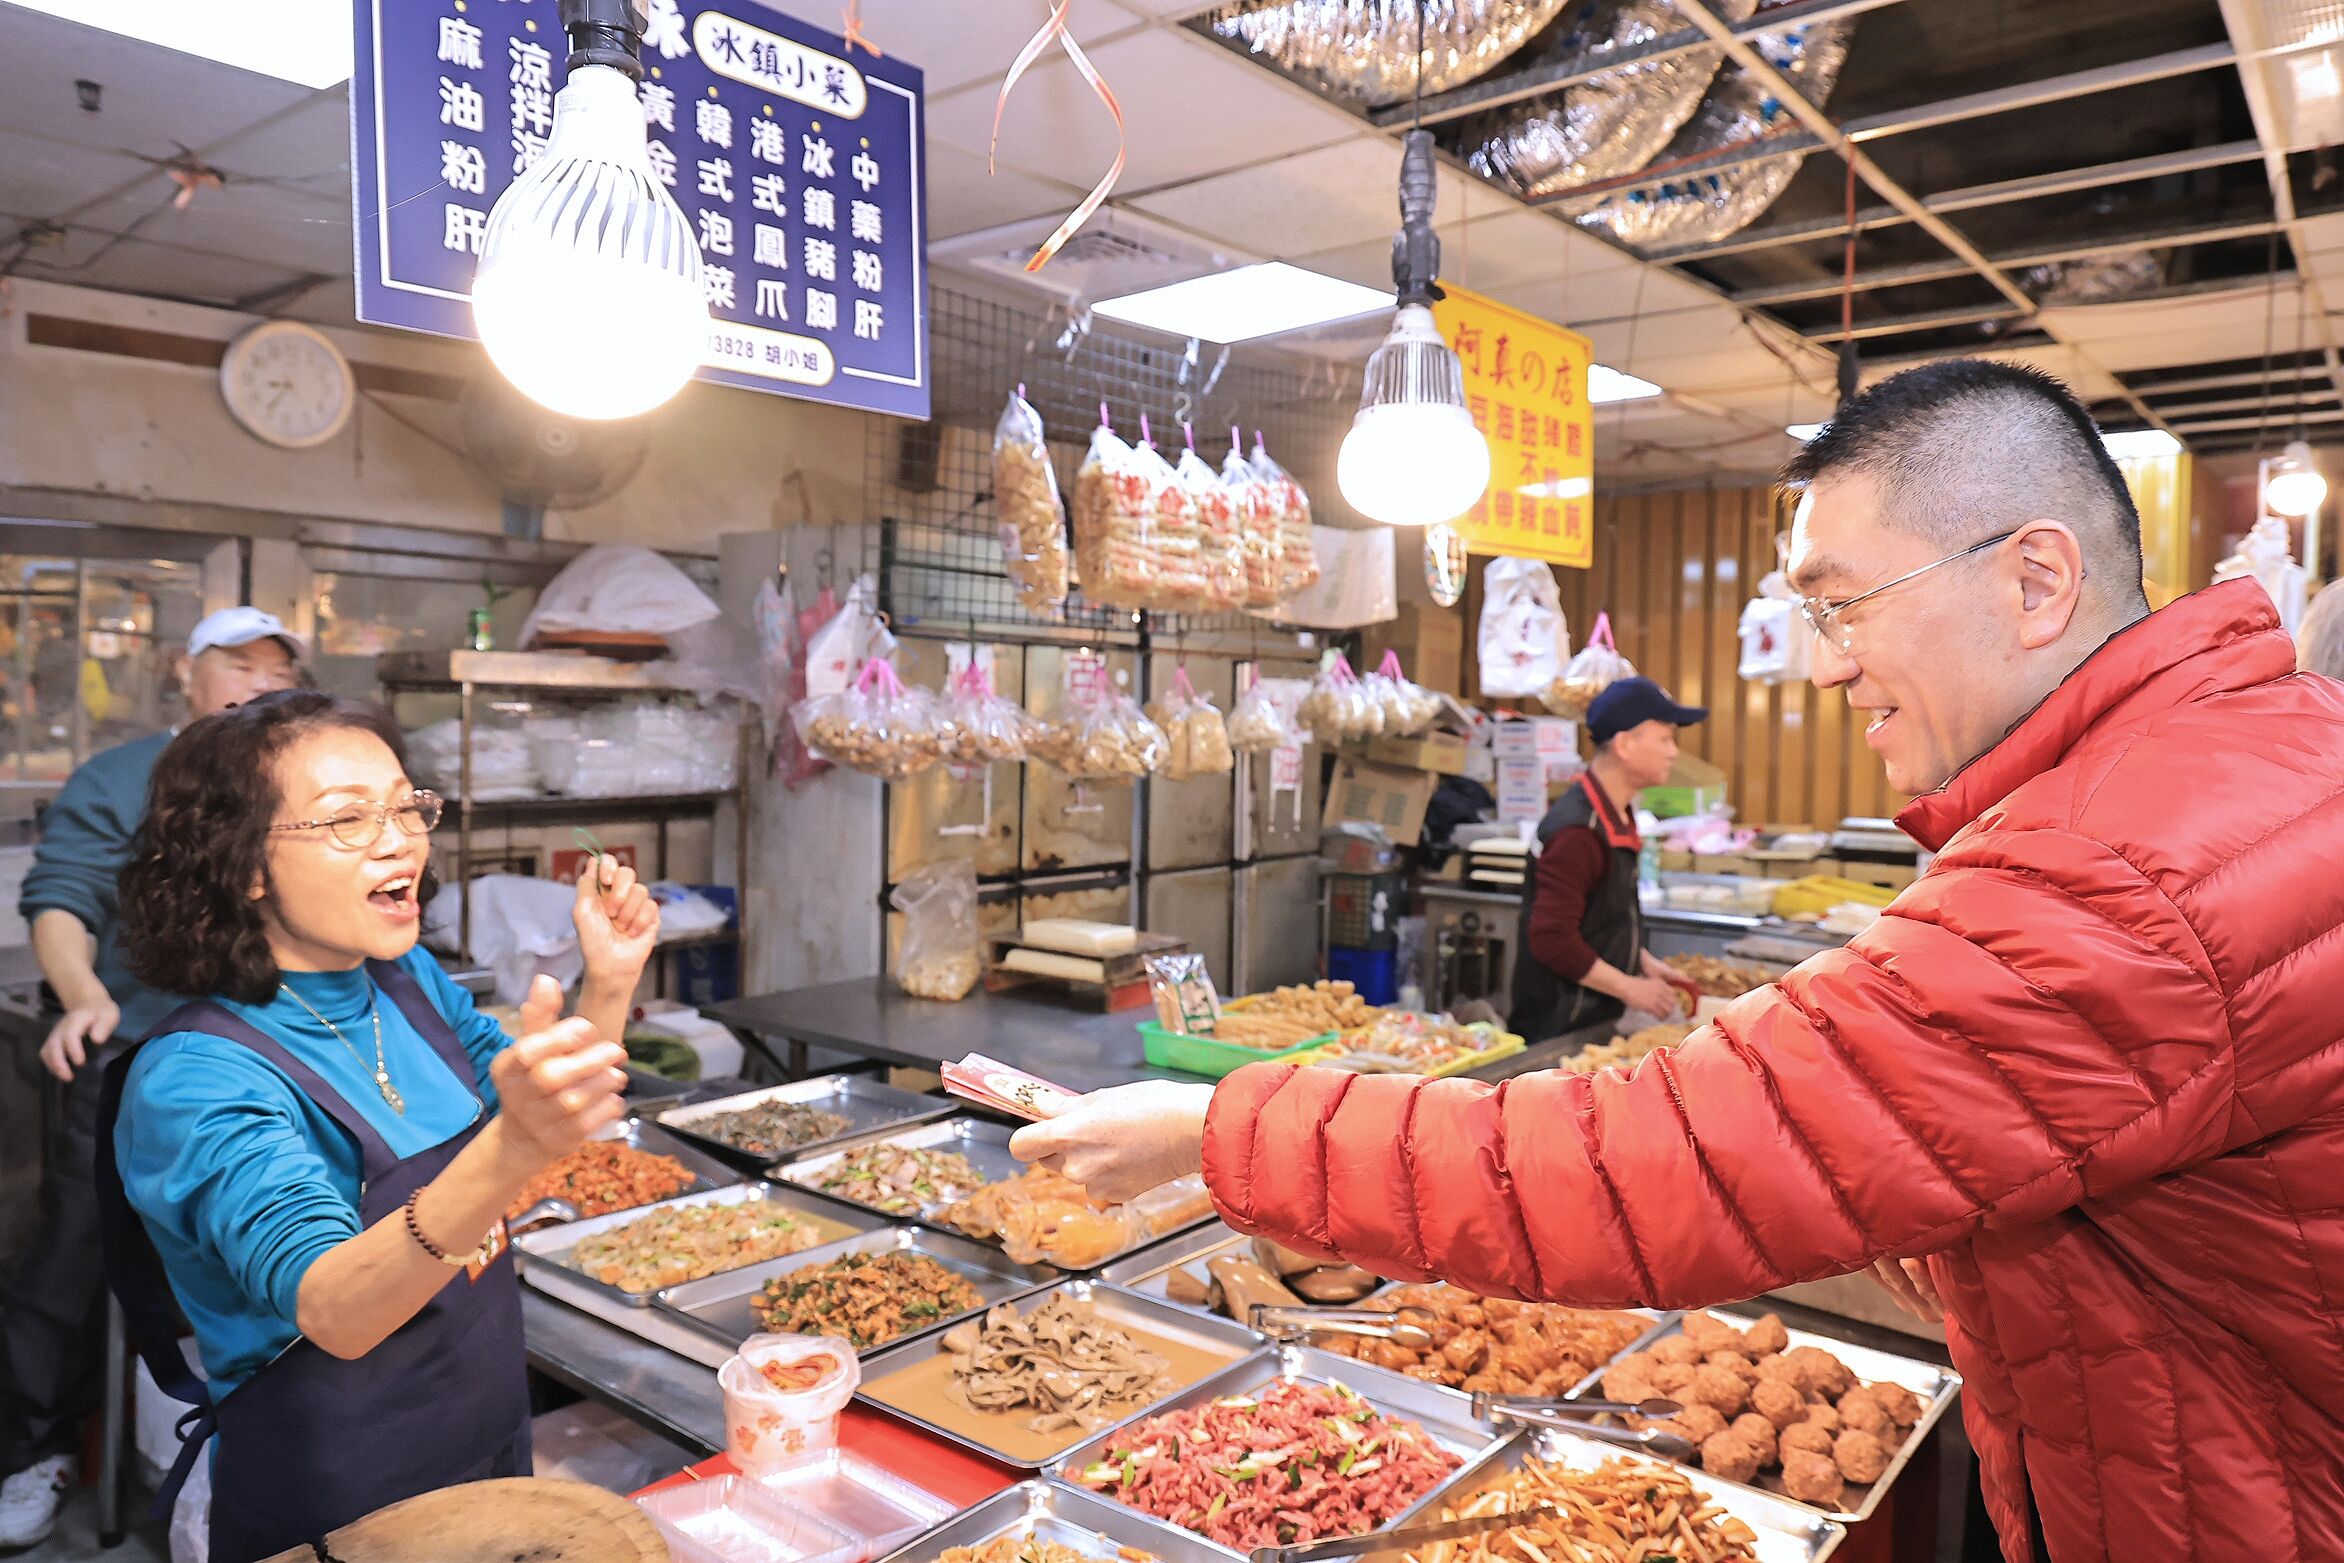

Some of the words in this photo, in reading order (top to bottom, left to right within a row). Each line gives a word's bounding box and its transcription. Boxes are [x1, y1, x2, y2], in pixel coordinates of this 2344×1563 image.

[437, 16, 487, 256] 麻油粉肝
[508, 36, 553, 182] 涼拌海
[711, 26, 850, 106] 冰鎮小菜
[694, 98, 737, 311] 韓式泡菜
[750, 116, 789, 322] 港式鳳爪
[802, 133, 838, 331] 冰鎮豬腳
[851, 151, 884, 341] 中藥粉肝
[764, 344, 818, 372] 胡小姐
